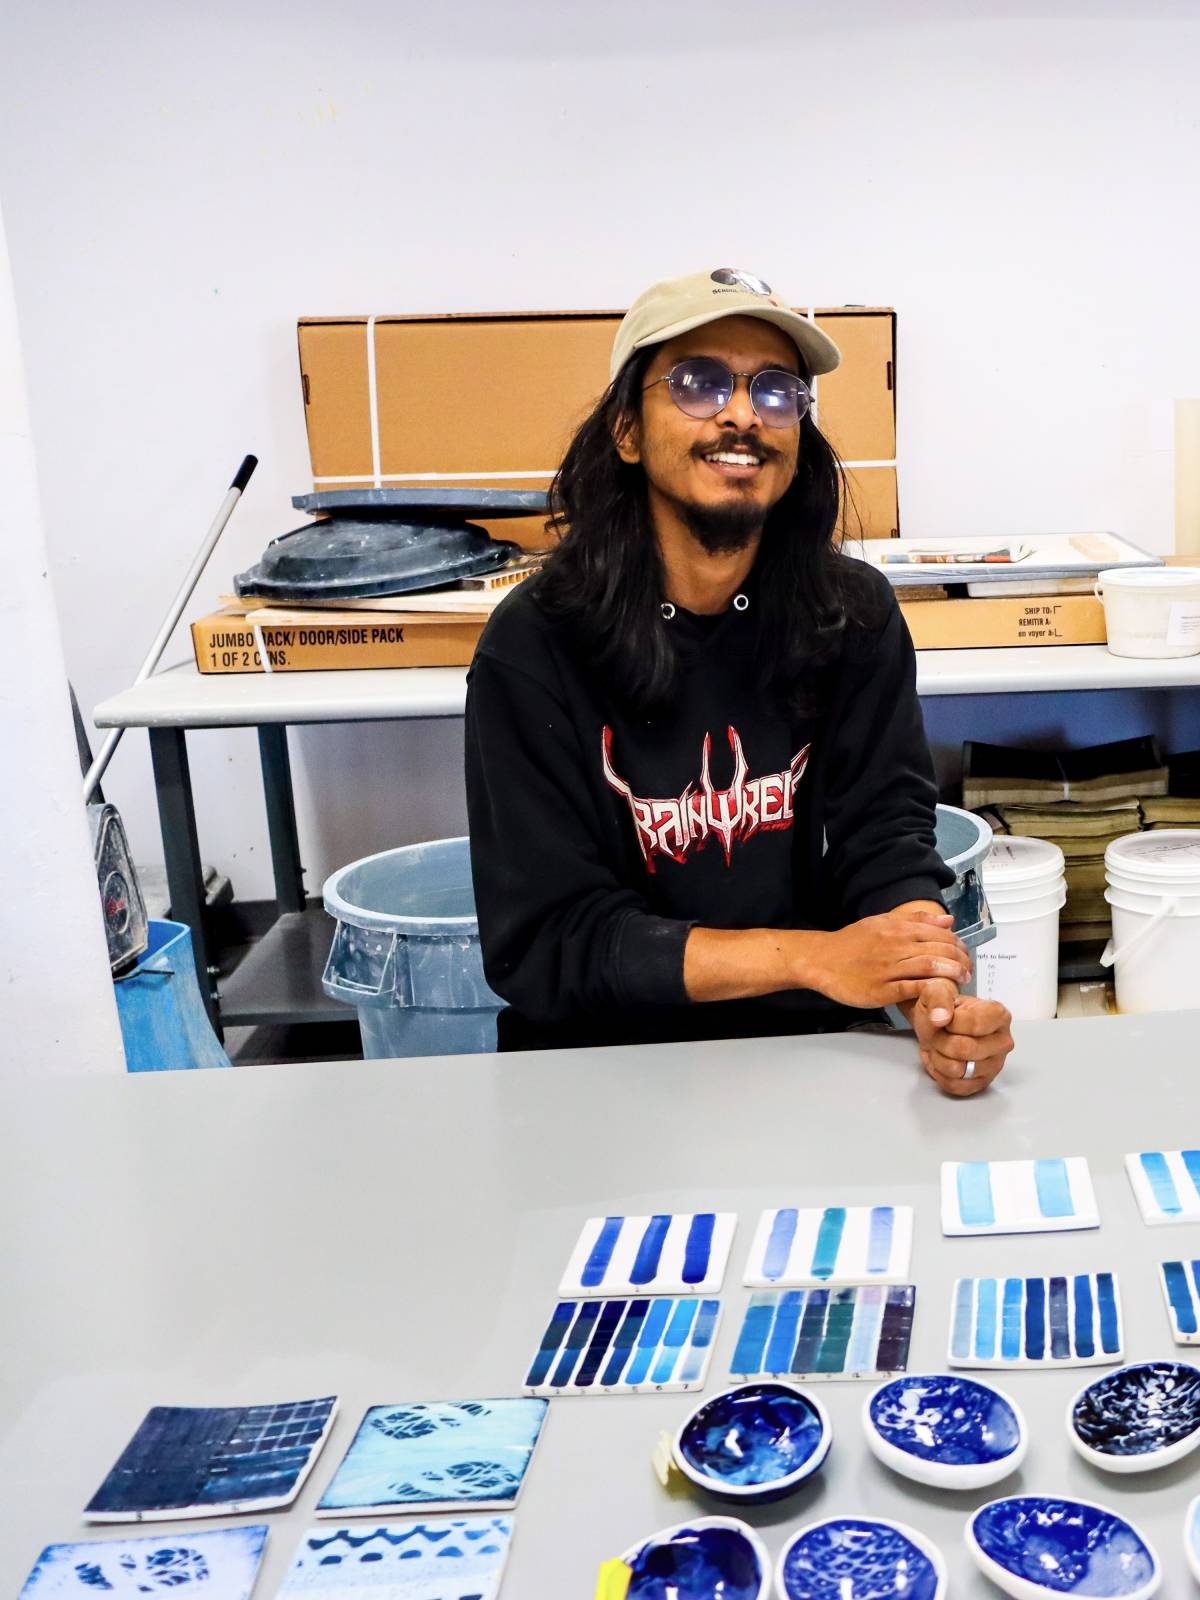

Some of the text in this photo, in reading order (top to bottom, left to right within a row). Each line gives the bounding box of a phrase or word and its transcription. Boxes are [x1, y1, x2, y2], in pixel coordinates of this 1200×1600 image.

[1024, 607, 1041, 615] SHIP
[209, 632, 254, 648] JUMBO
[299, 628, 368, 646] DOOR/SIDE
[371, 627, 405, 644] PACK
[210, 650, 291, 667] 1 OF 2 CNS.
